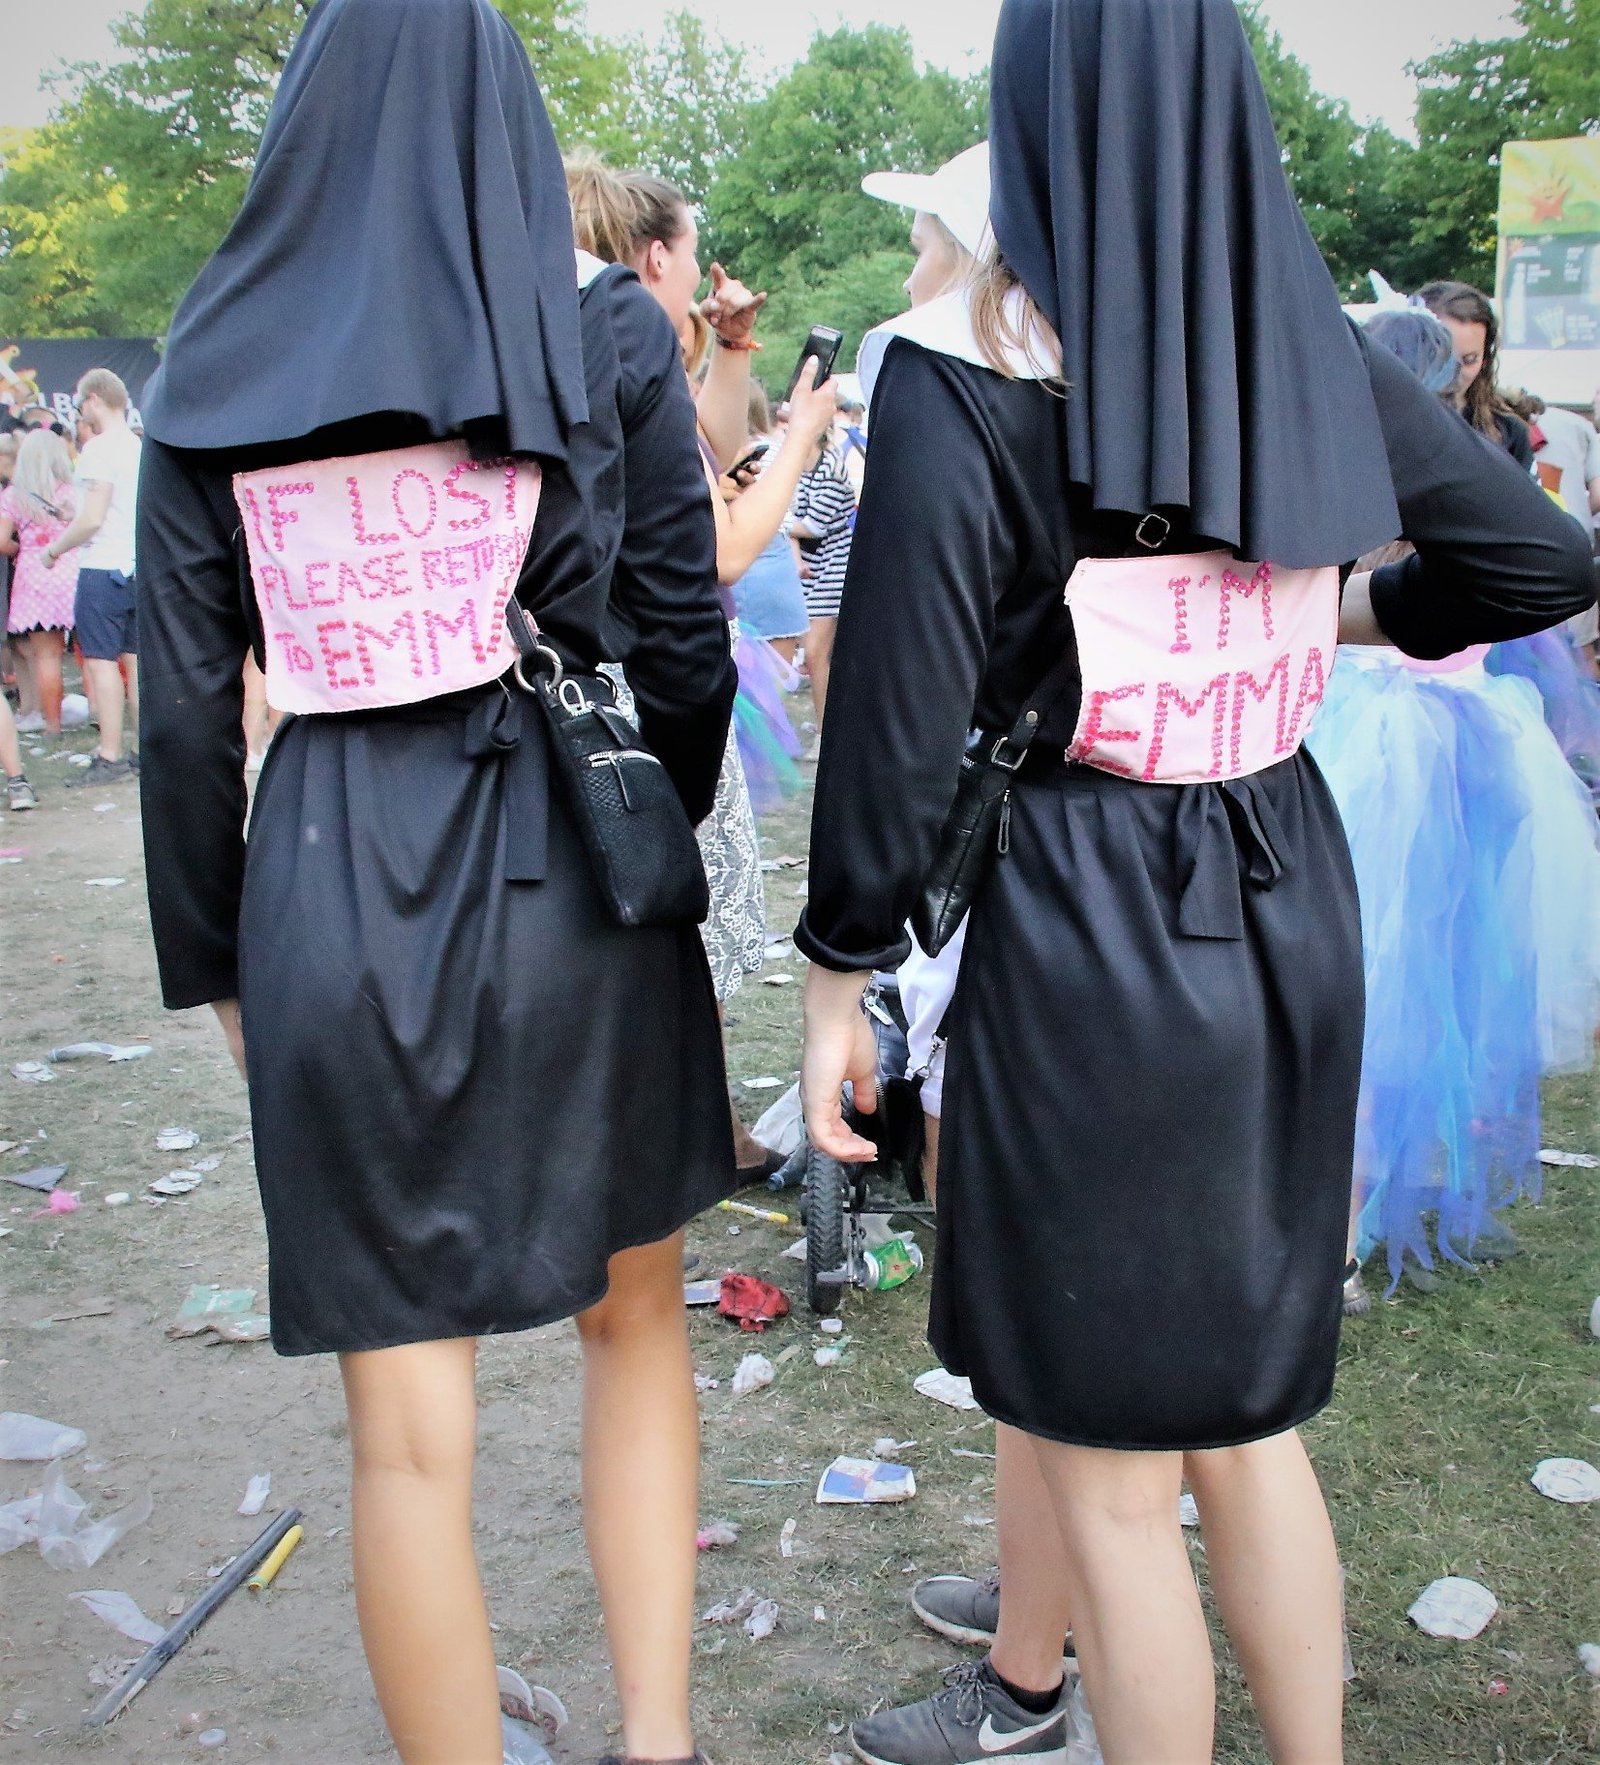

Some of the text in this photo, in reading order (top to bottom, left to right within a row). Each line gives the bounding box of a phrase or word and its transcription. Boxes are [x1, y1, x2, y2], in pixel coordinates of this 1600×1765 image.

[245, 457, 516, 552] IF LOST
[259, 551, 412, 611] PLEASE
[1168, 561, 1274, 654] I'M
[275, 632, 314, 673] TO
[1074, 647, 1323, 780] EMMA
